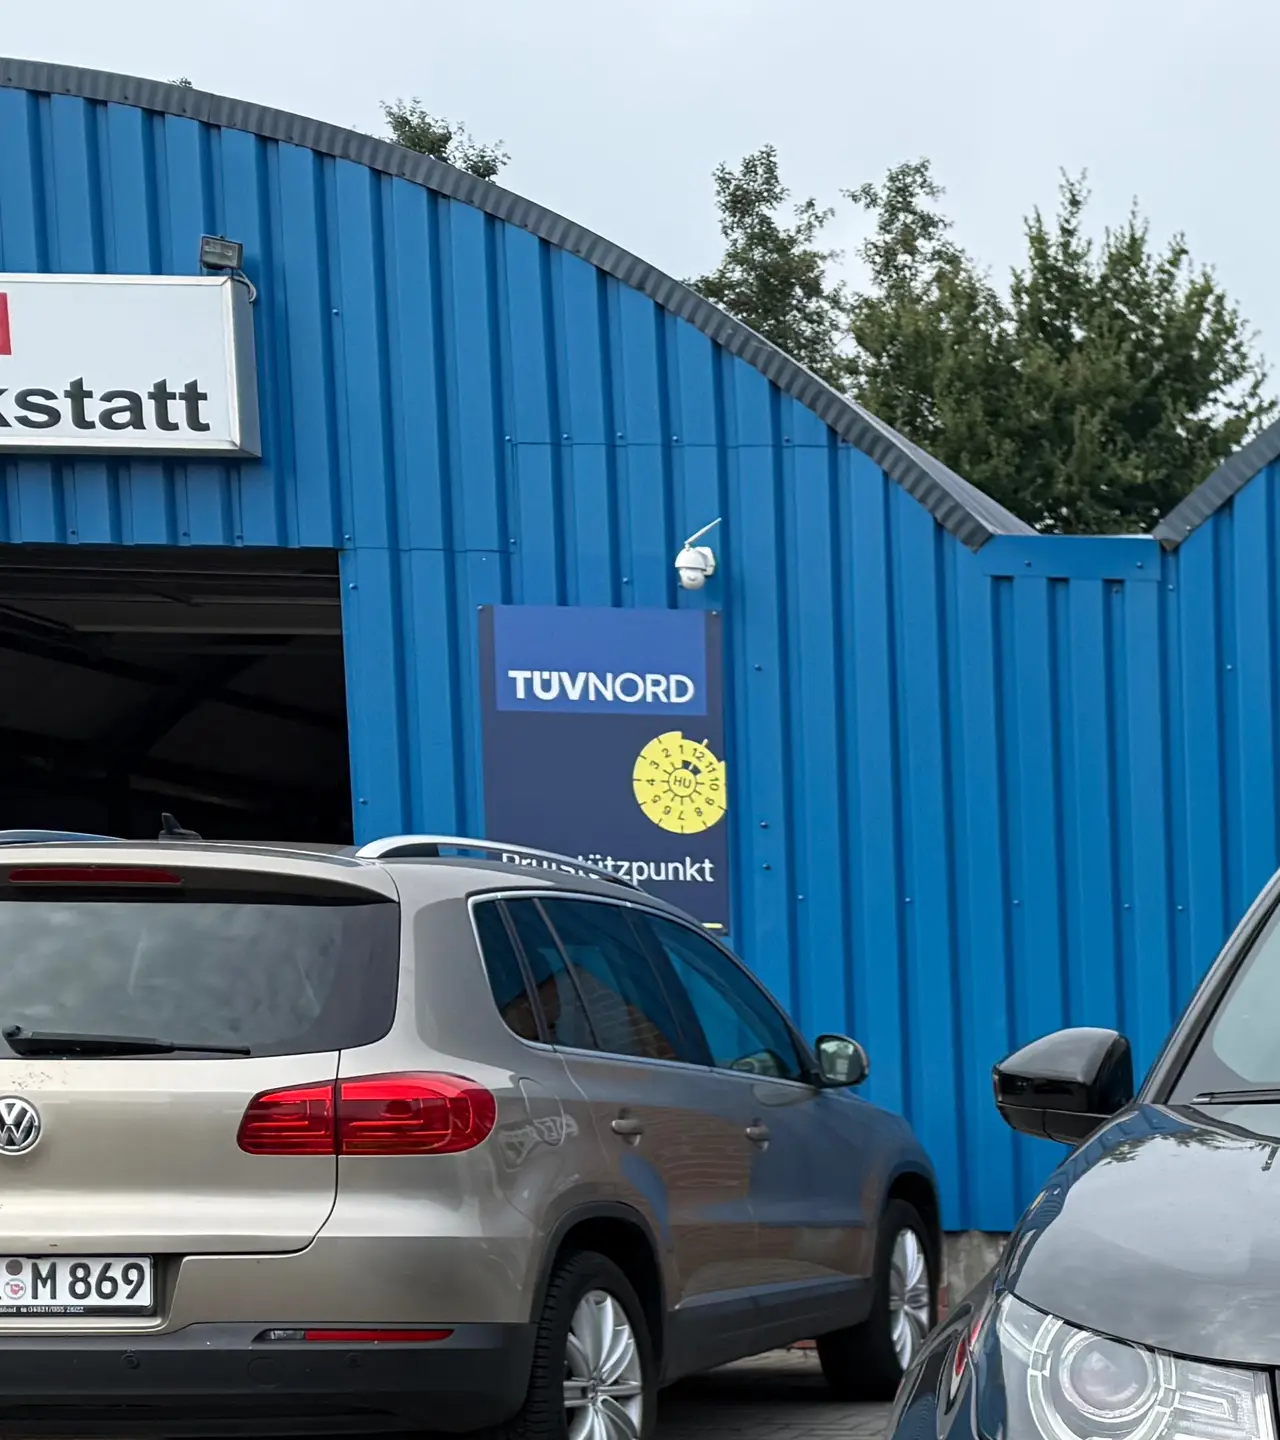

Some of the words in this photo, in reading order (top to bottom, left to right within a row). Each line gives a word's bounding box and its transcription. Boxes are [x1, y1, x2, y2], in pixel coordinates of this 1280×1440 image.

[0, 377, 211, 432] statt
[673, 775, 692, 789] HU
[31, 1261, 57, 1300] M
[68, 1261, 145, 1300] 869
